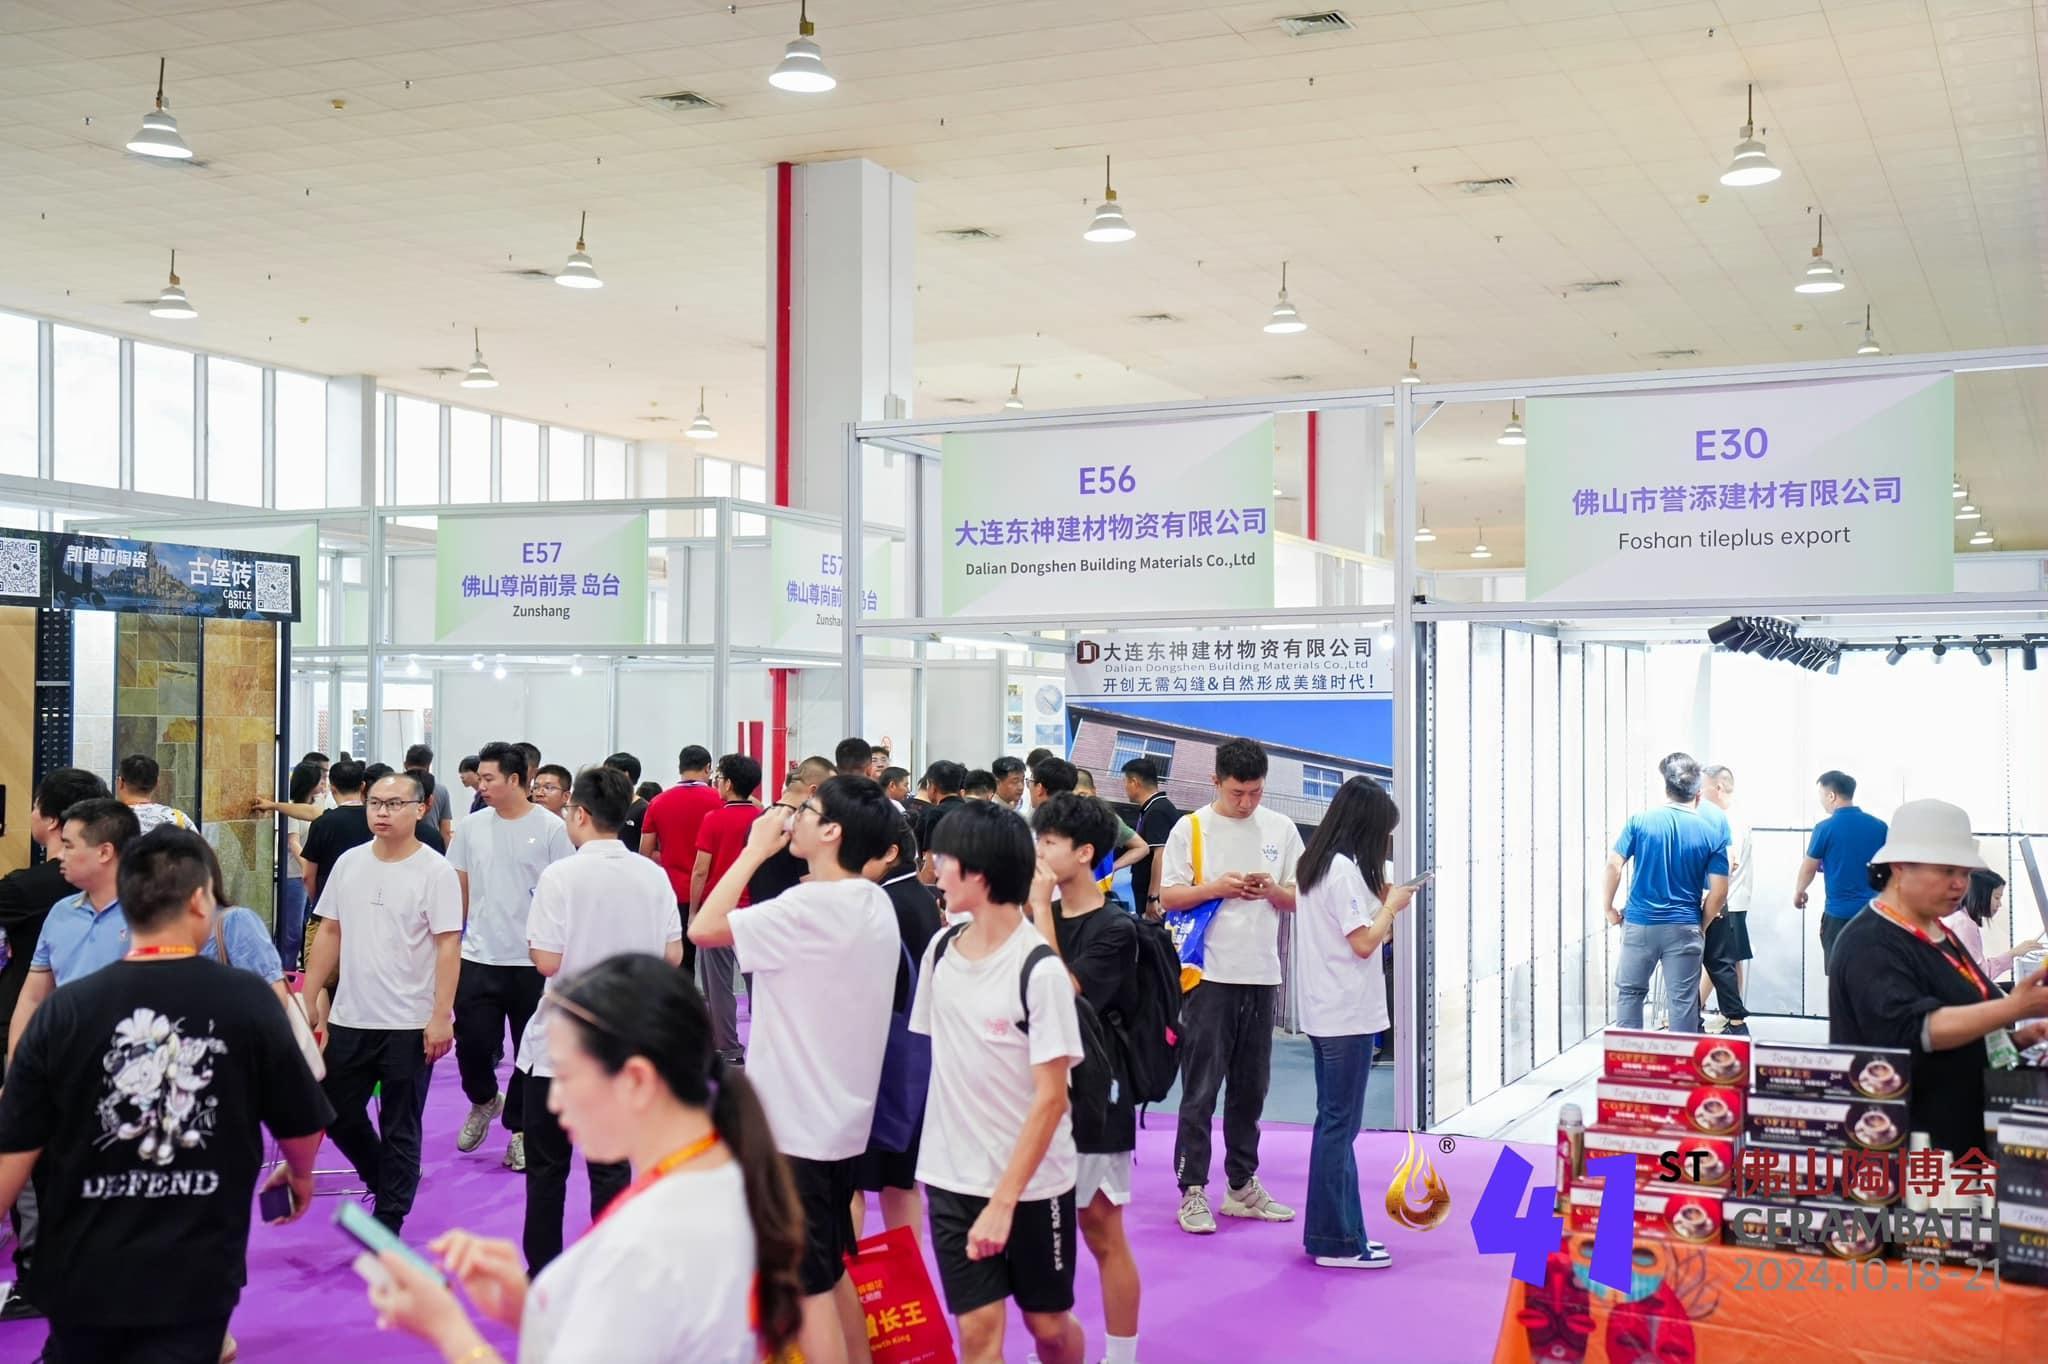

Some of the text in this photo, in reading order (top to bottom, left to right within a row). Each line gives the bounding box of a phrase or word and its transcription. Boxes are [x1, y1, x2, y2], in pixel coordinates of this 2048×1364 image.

[1695, 427, 1768, 461] E30
[1079, 465, 1136, 495] E56
[1572, 476, 1902, 516] 佛山市誉添建材有限公司
[955, 507, 1267, 547] 大连东神建材物资有限公司
[1619, 526, 1851, 551] Foshan tileplus export
[67, 545, 147, 569] 凯迪亚陶瓷
[522, 542, 562, 563] E57
[966, 552, 1256, 577] Dalian Dongshen Building Materials Co.,Ltd
[188, 557, 251, 589] 古堡砖
[462, 573, 620, 598] 佛山尊尚前景 岛台
[223, 589, 252, 600] CASTLE
[228, 599, 252, 610] BRICK
[787, 580, 842, 607] 佛山尊尚前
[513, 604, 570, 619] Zunshang
[1103, 638, 1372, 662] 大连东神建材物资有限公司
[1105, 664, 1142, 674] Dalian
[1146, 662, 1205, 674] Dongshen
[1209, 661, 1260, 673] Building
[1263, 660, 1320, 671] Materials
[82, 1169, 219, 1198] DEFEND
